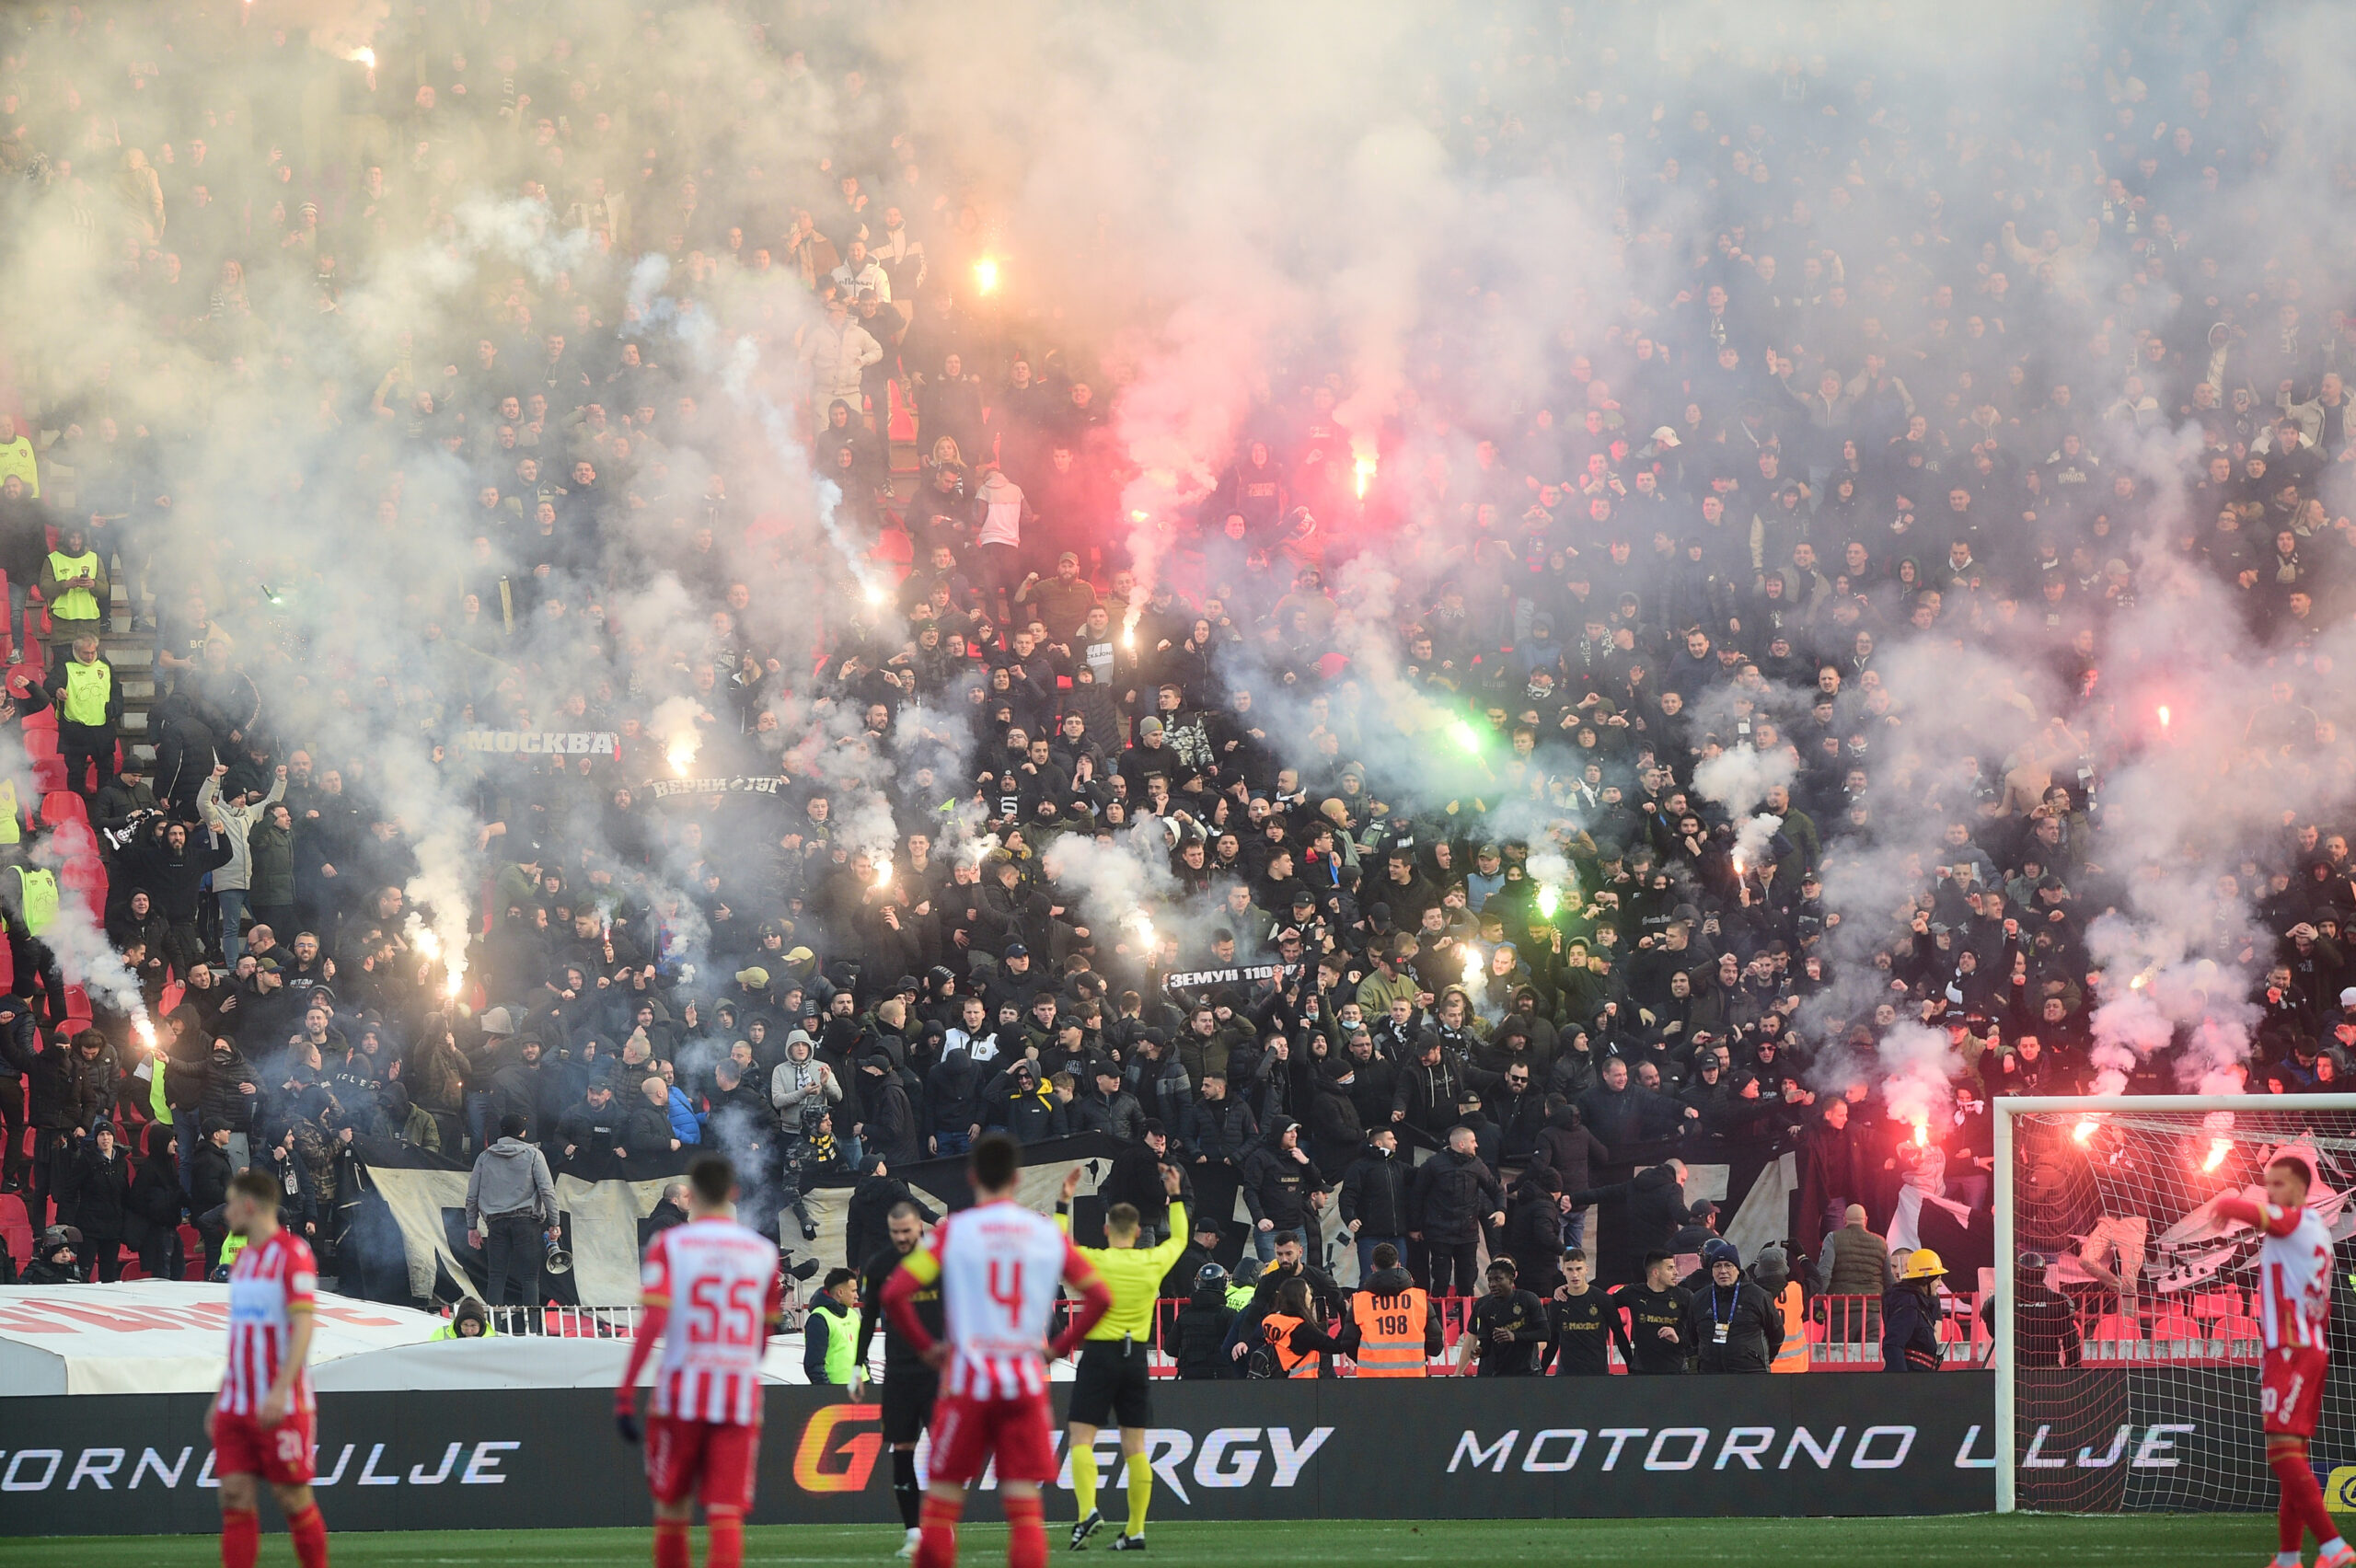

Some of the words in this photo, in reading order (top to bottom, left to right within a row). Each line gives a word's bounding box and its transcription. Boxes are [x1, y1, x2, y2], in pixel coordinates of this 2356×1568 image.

[467, 732, 613, 754] МОСКВА
[653, 778, 727, 798] ВЕРНИ
[1170, 969, 1239, 987] ЗЕМУН
[1243, 963, 1298, 980] 1100
[988, 1258, 1023, 1329] 4
[1371, 1293, 1412, 1310] FOTO
[689, 1275, 759, 1346] 55
[1646, 1315, 1679, 1324] MAXBET
[1376, 1315, 1408, 1335] 198
[1568, 1322, 1600, 1331] MAXBET
[1448, 1425, 1917, 1472] MOTORNO
[1954, 1424, 2196, 1469] ULJE
[307, 1441, 521, 1485] ULJE
